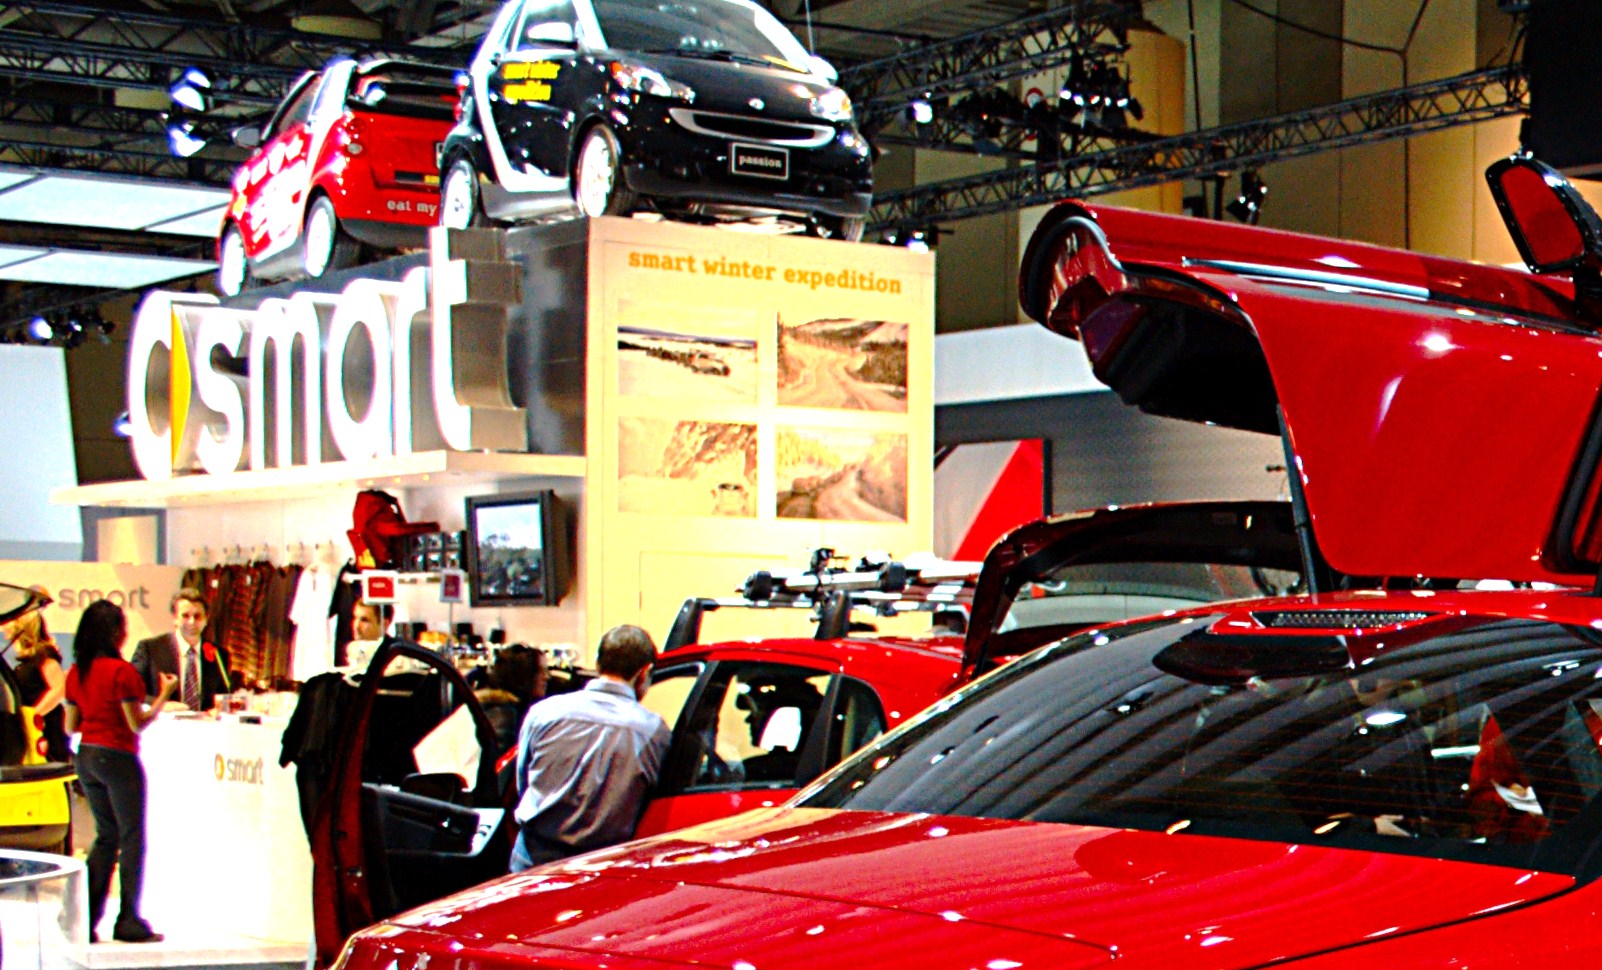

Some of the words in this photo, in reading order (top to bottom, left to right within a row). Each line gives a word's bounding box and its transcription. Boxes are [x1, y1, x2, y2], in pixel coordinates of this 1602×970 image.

[738, 154, 783, 168] passion
[416, 202, 438, 217] my
[628, 251, 697, 273] smart
[703, 257, 777, 281] winter
[784, 267, 902, 294] expedition
[196, 226, 472, 477] smart
[58, 586, 150, 610] smart
[226, 756, 264, 785] smart
